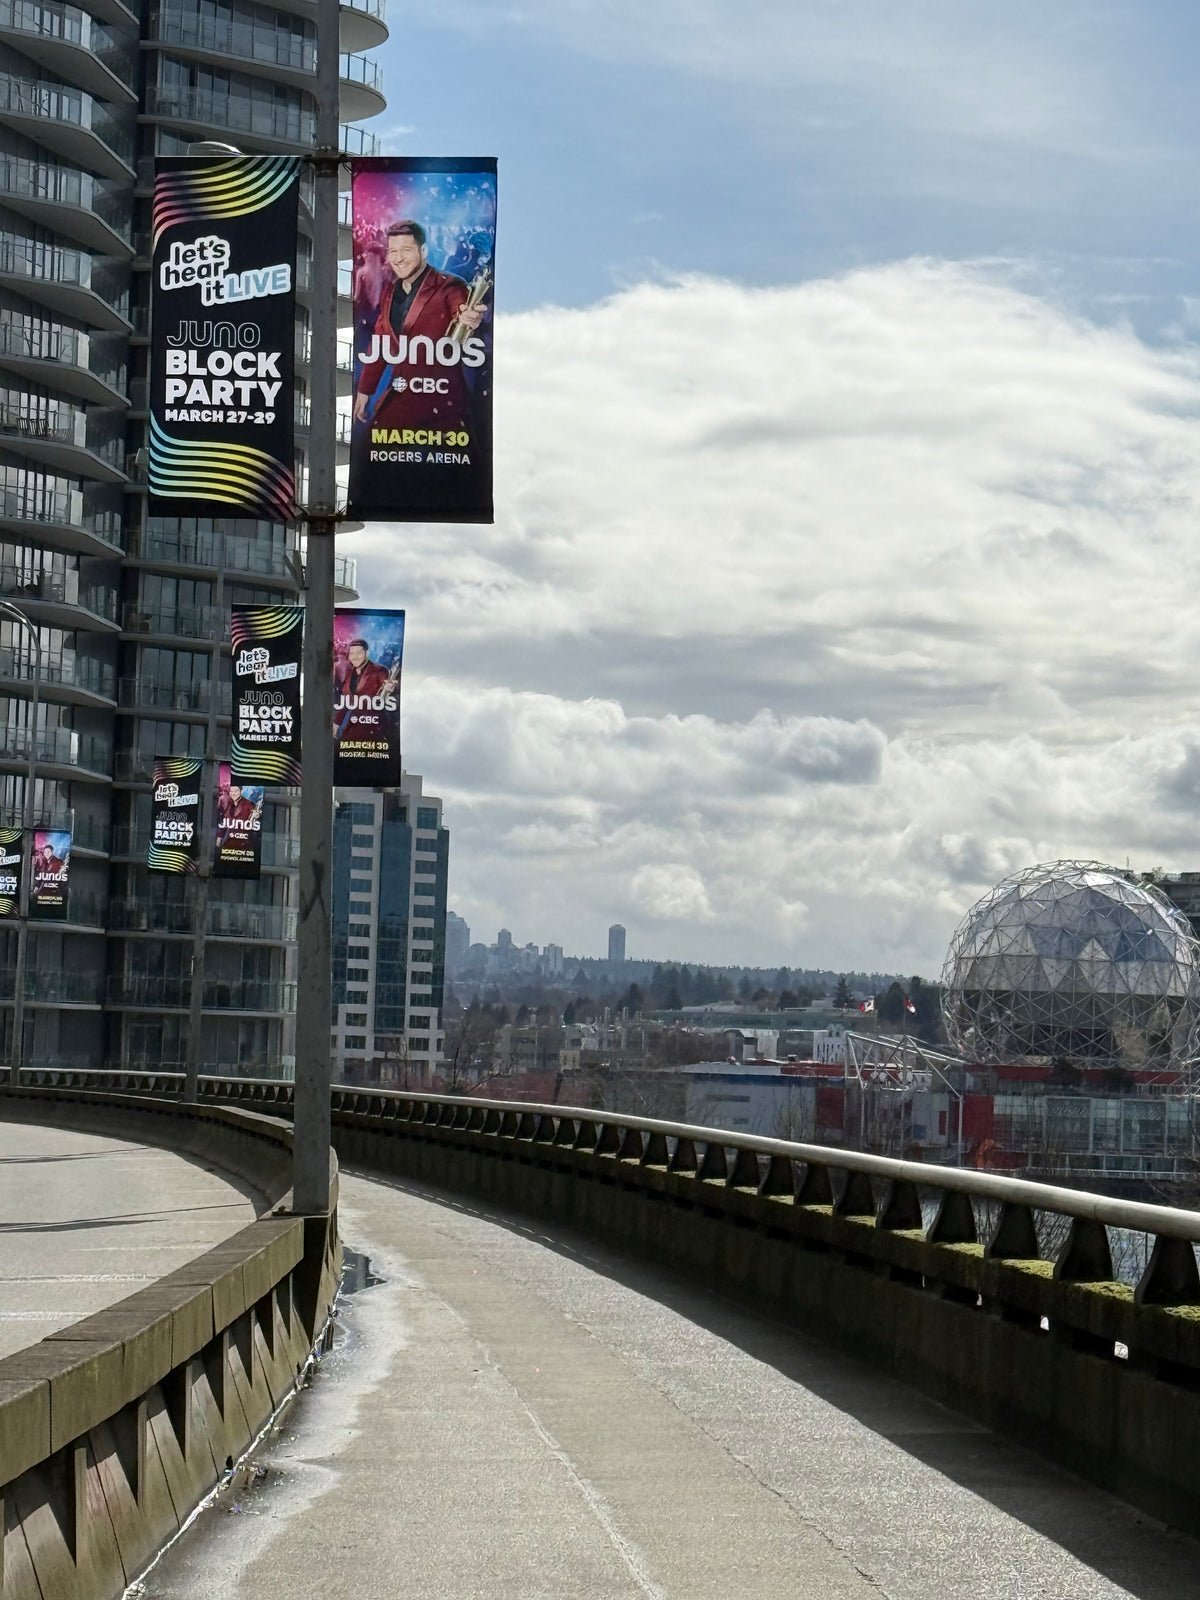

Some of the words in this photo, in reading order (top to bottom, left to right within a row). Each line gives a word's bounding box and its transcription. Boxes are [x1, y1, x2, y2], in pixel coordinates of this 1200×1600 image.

[175, 240, 226, 265] let's
[165, 262, 225, 286] hear
[206, 281, 225, 302] it
[228, 268, 287, 298] LIVE
[166, 350, 281, 378] BLOCK
[165, 378, 283, 407] PARTY
[409, 377, 449, 394] CBC
[165, 409, 224, 423] MARCH
[226, 411, 276, 425] 27-29
[371, 428, 442, 446] MARCH
[445, 431, 470, 447] 30
[370, 450, 422, 463] ROGERS
[426, 452, 471, 465] ARENA
[268, 664, 297, 680] LIVE
[239, 705, 293, 720] BLOCK
[239, 719, 294, 734] PARTY
[155, 820, 194, 832] BLOCK
[154, 830, 194, 841] PARTY
